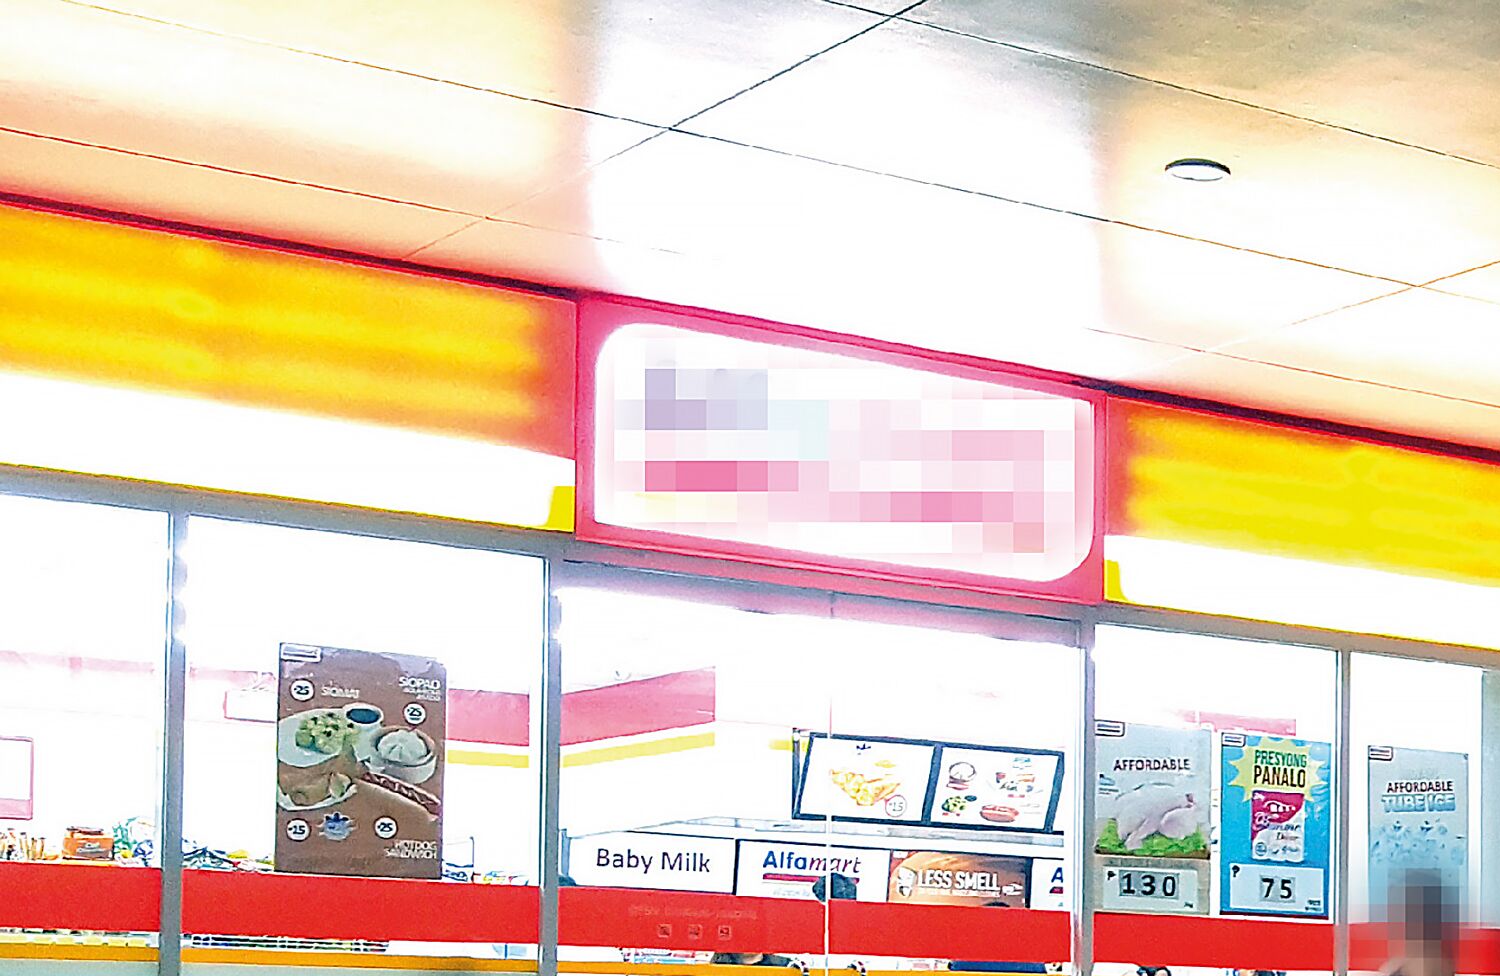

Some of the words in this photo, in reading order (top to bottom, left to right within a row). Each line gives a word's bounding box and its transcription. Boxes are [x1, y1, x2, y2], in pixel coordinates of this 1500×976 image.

[398, 676, 441, 690] SIOPAO
[1113, 759, 1192, 771] AFFORDABLE
[1254, 749, 1307, 768] PRESYONG
[1253, 765, 1306, 788] PANALO
[1387, 780, 1454, 793] AFFORDABLE
[394, 840, 438, 850] HOTDOG
[596, 848, 653, 874] Baby
[661, 851, 710, 873] Milk
[762, 850, 861, 873] Alfamart
[918, 869, 952, 889] LESS
[955, 871, 1000, 892] SMELL
[1122, 873, 1176, 897] 130
[1261, 878, 1292, 899] 75
